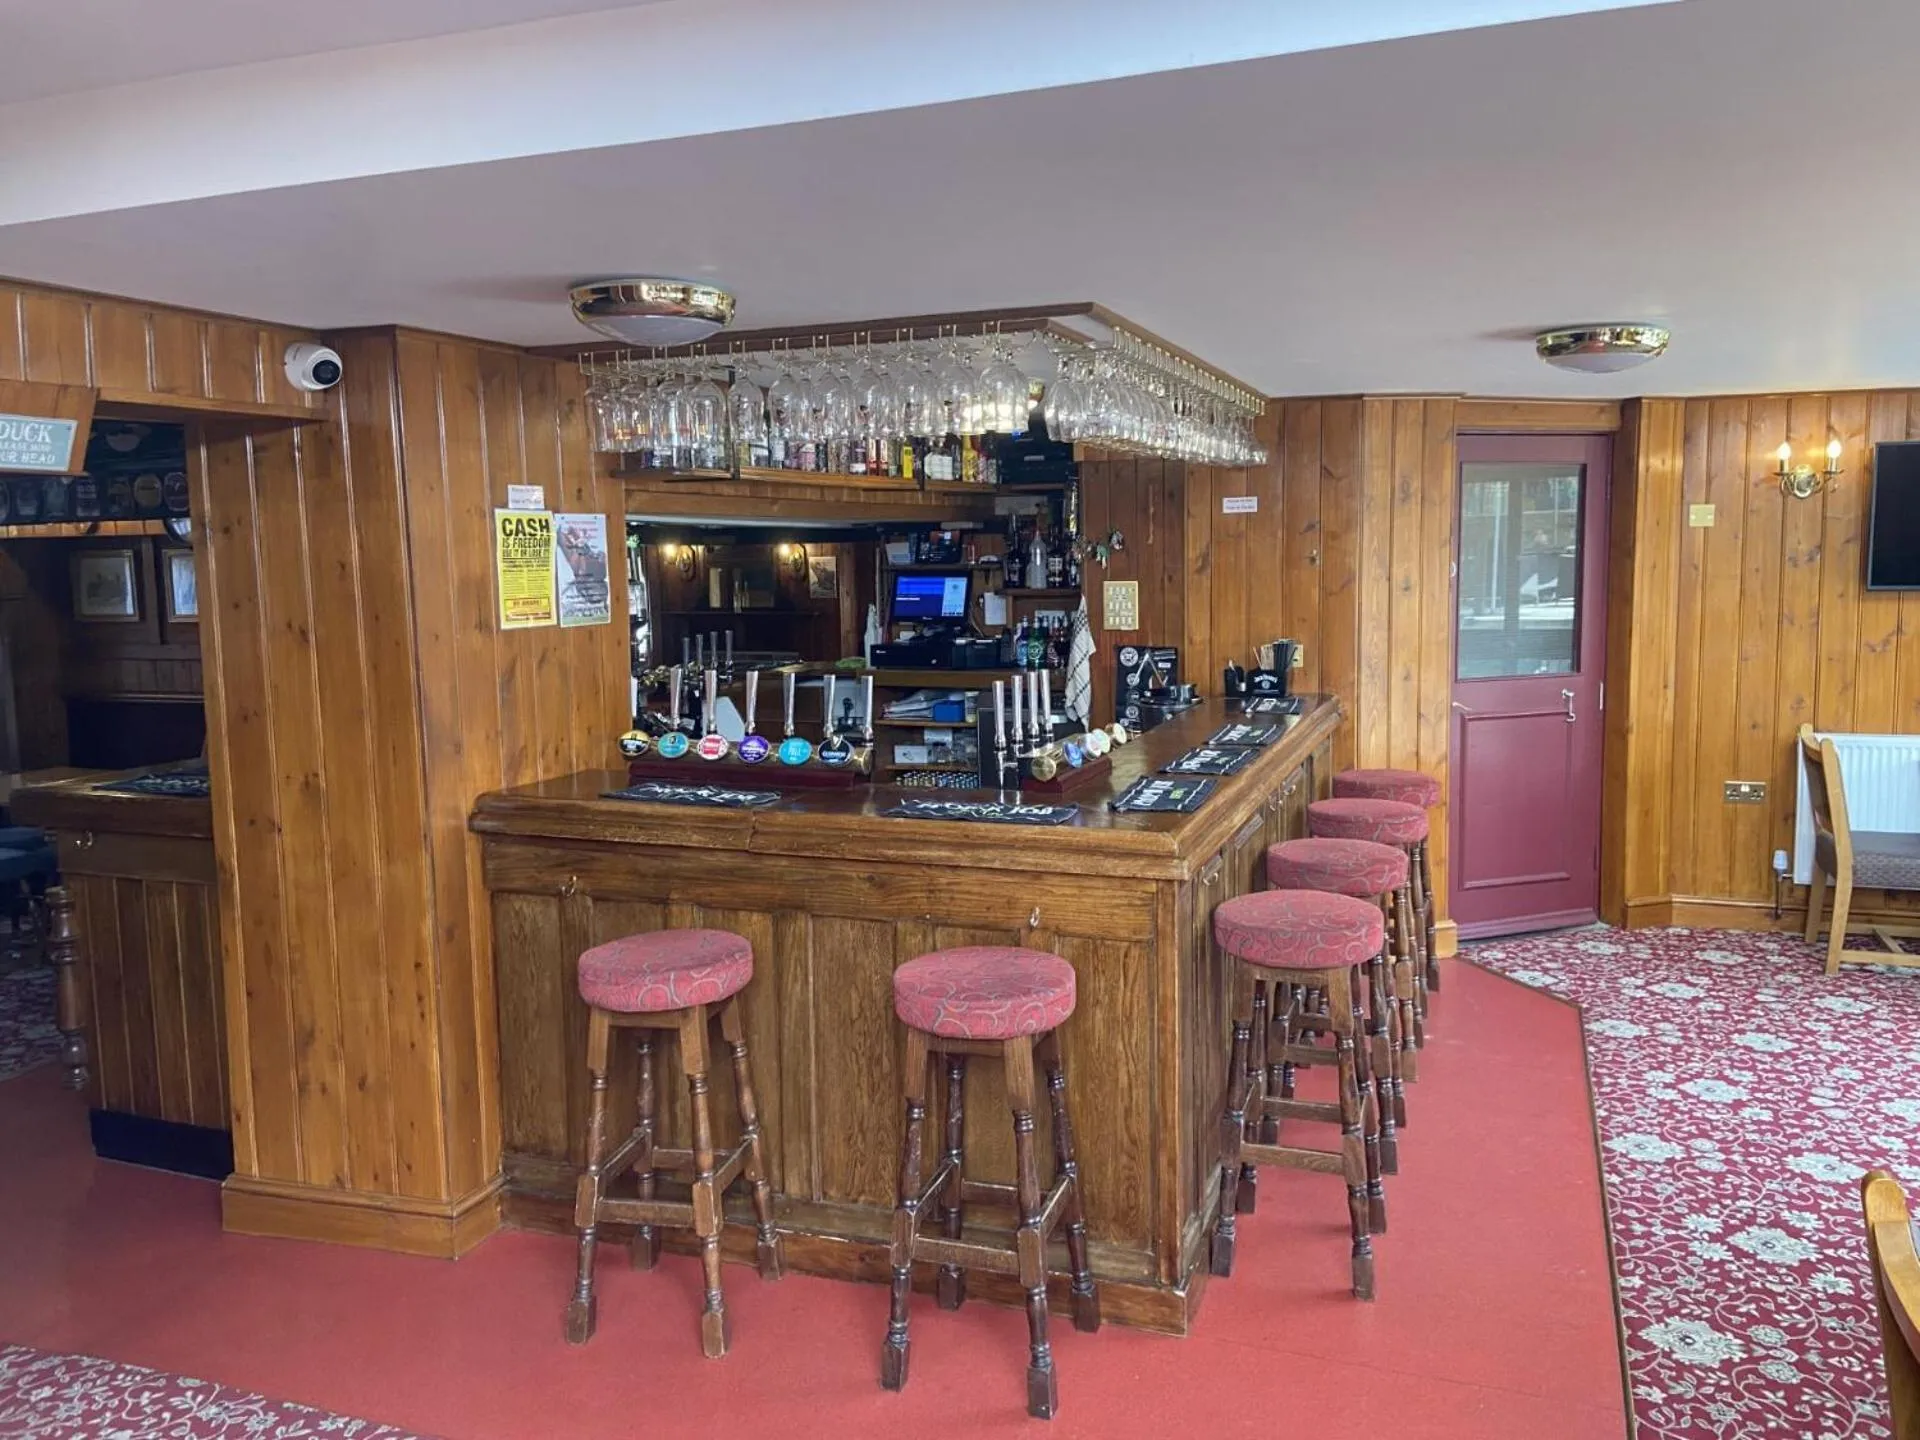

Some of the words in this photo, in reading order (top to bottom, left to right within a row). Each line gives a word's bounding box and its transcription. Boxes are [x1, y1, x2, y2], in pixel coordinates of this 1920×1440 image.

[0, 421, 53, 444] DUCK
[502, 518, 550, 537] CASH
[503, 537, 510, 549] IS
[513, 536, 551, 549] FREEDOM
